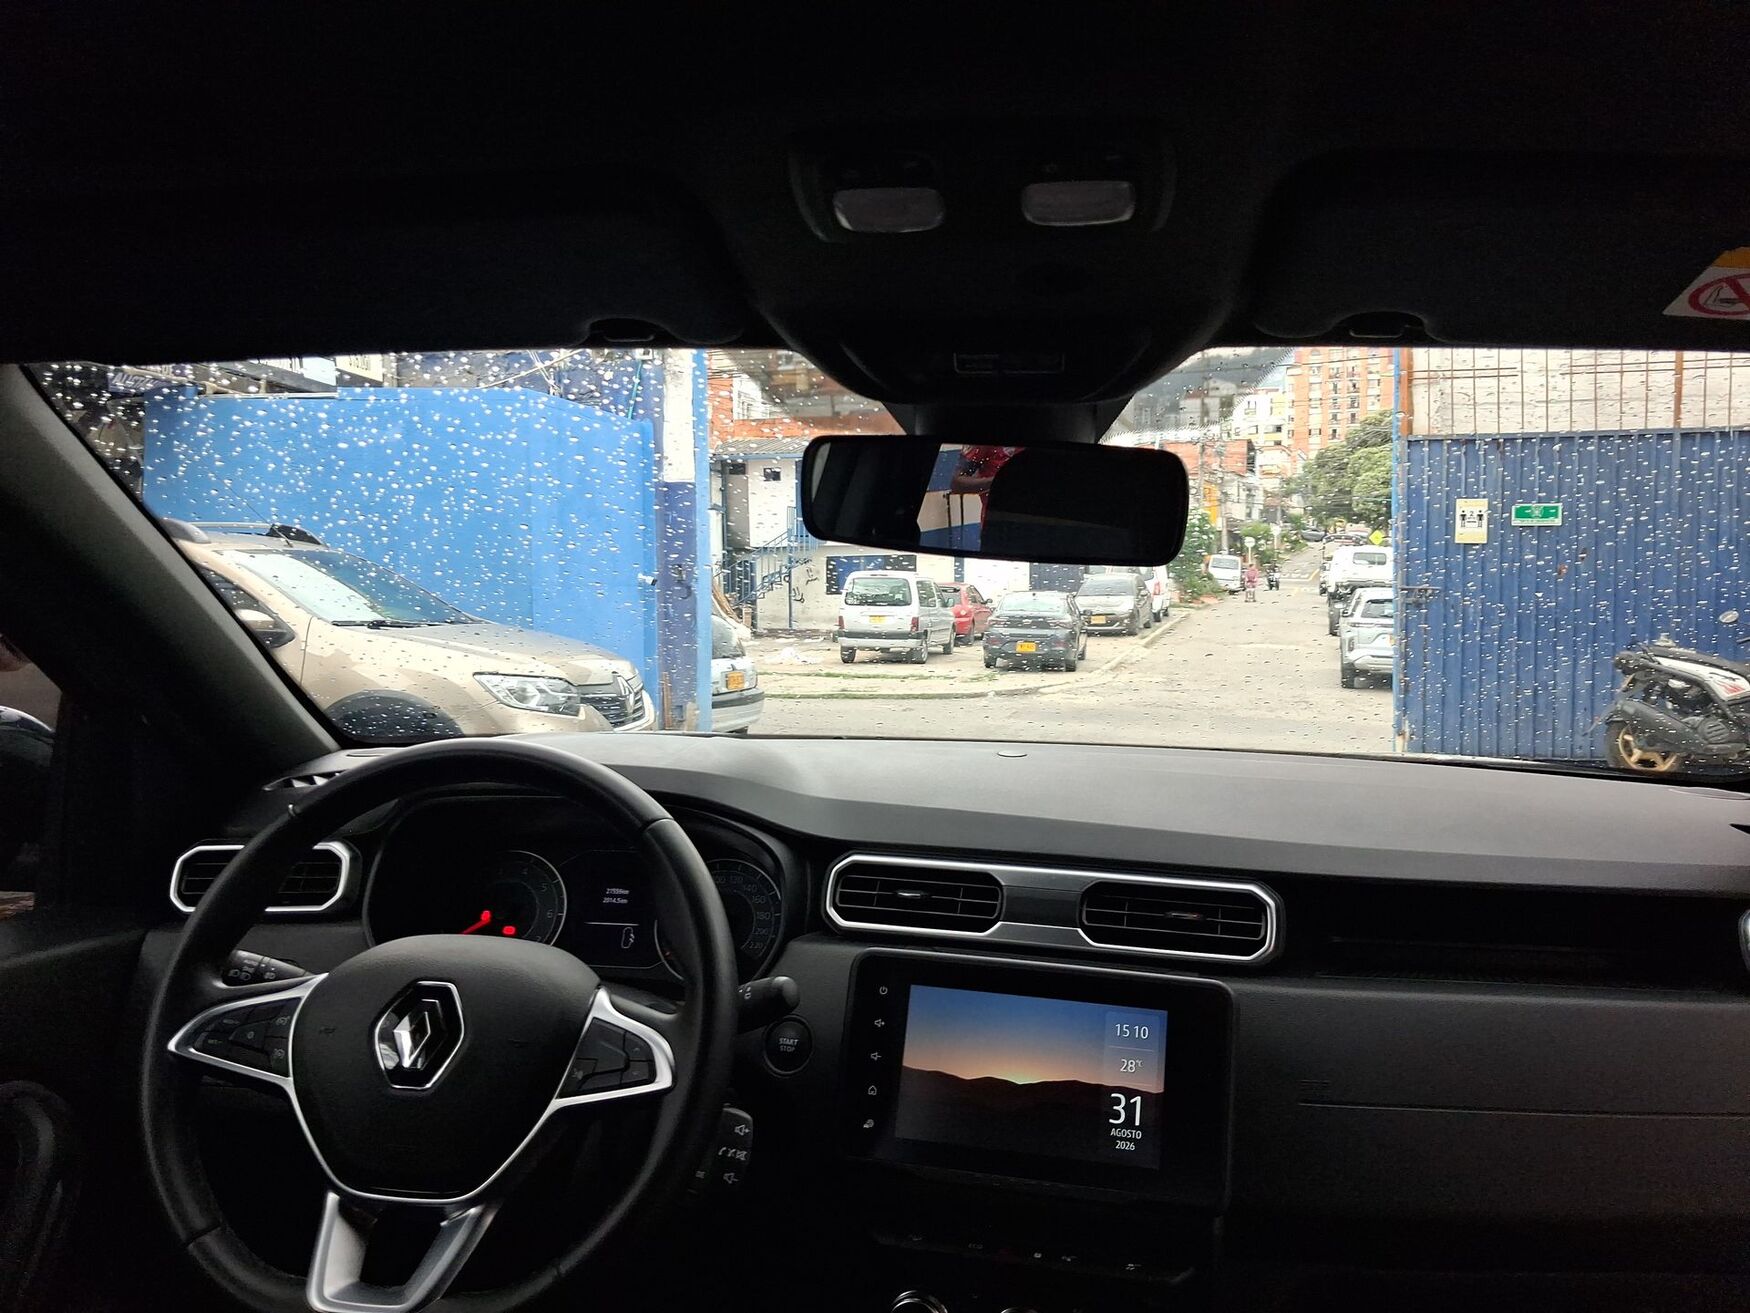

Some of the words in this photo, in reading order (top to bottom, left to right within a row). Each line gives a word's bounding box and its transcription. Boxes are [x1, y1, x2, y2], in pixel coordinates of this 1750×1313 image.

[1115, 1023, 1130, 1037] 15
[1133, 1025, 1149, 1039] 10
[778, 1038, 798, 1046] START
[1108, 1092, 1142, 1126] 31
[1110, 1128, 1142, 1140] AGOSTO
[1115, 1140, 1136, 1151] 2026
